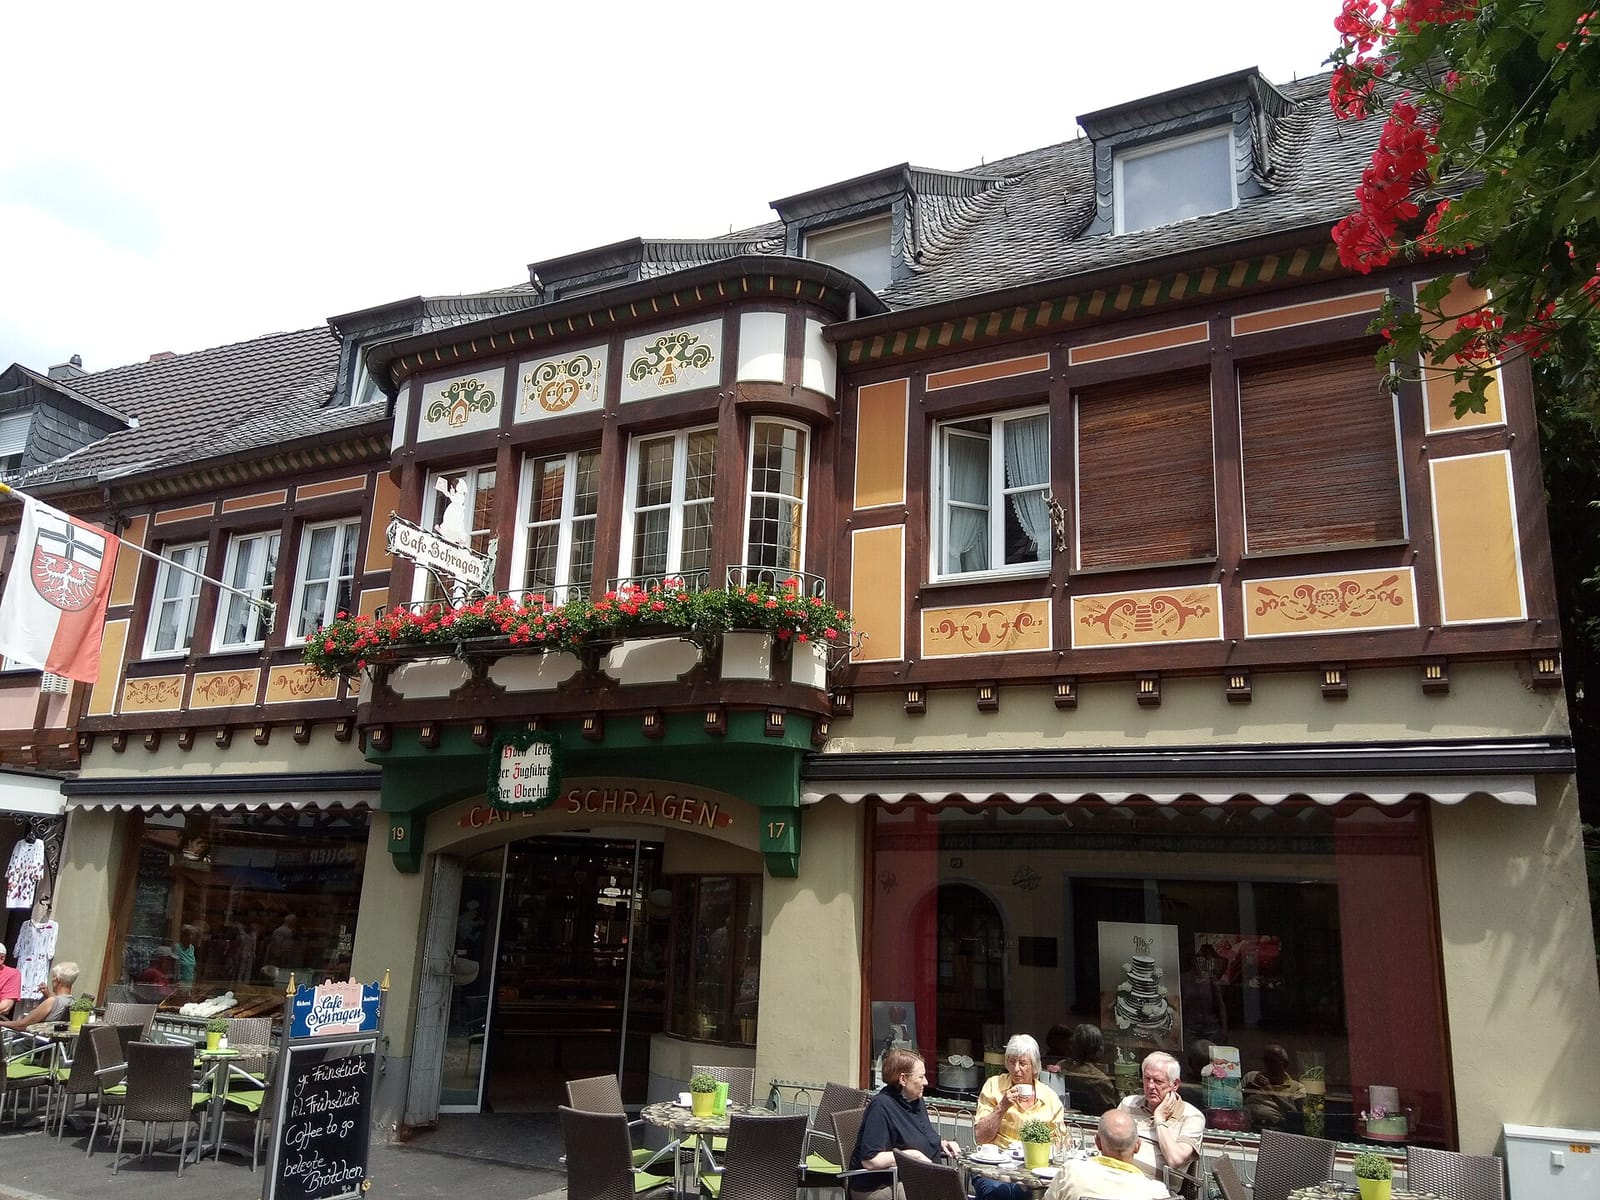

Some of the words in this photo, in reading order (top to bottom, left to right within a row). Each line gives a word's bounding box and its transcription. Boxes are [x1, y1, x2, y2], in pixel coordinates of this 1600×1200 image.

[400, 529, 427, 554] Cafe
[428, 540, 481, 578] Schragen
[567, 789, 720, 829] SCHRAGEN
[391, 826, 405, 840] 19
[767, 822, 785, 839] 17
[321, 995, 343, 1012] Café
[307, 1006, 363, 1030] Schragen
[305, 1085, 361, 1115] Frühstück
[285, 1121, 323, 1152] Coffee
[326, 1112, 338, 1135] to
[339, 1120, 355, 1139] go
